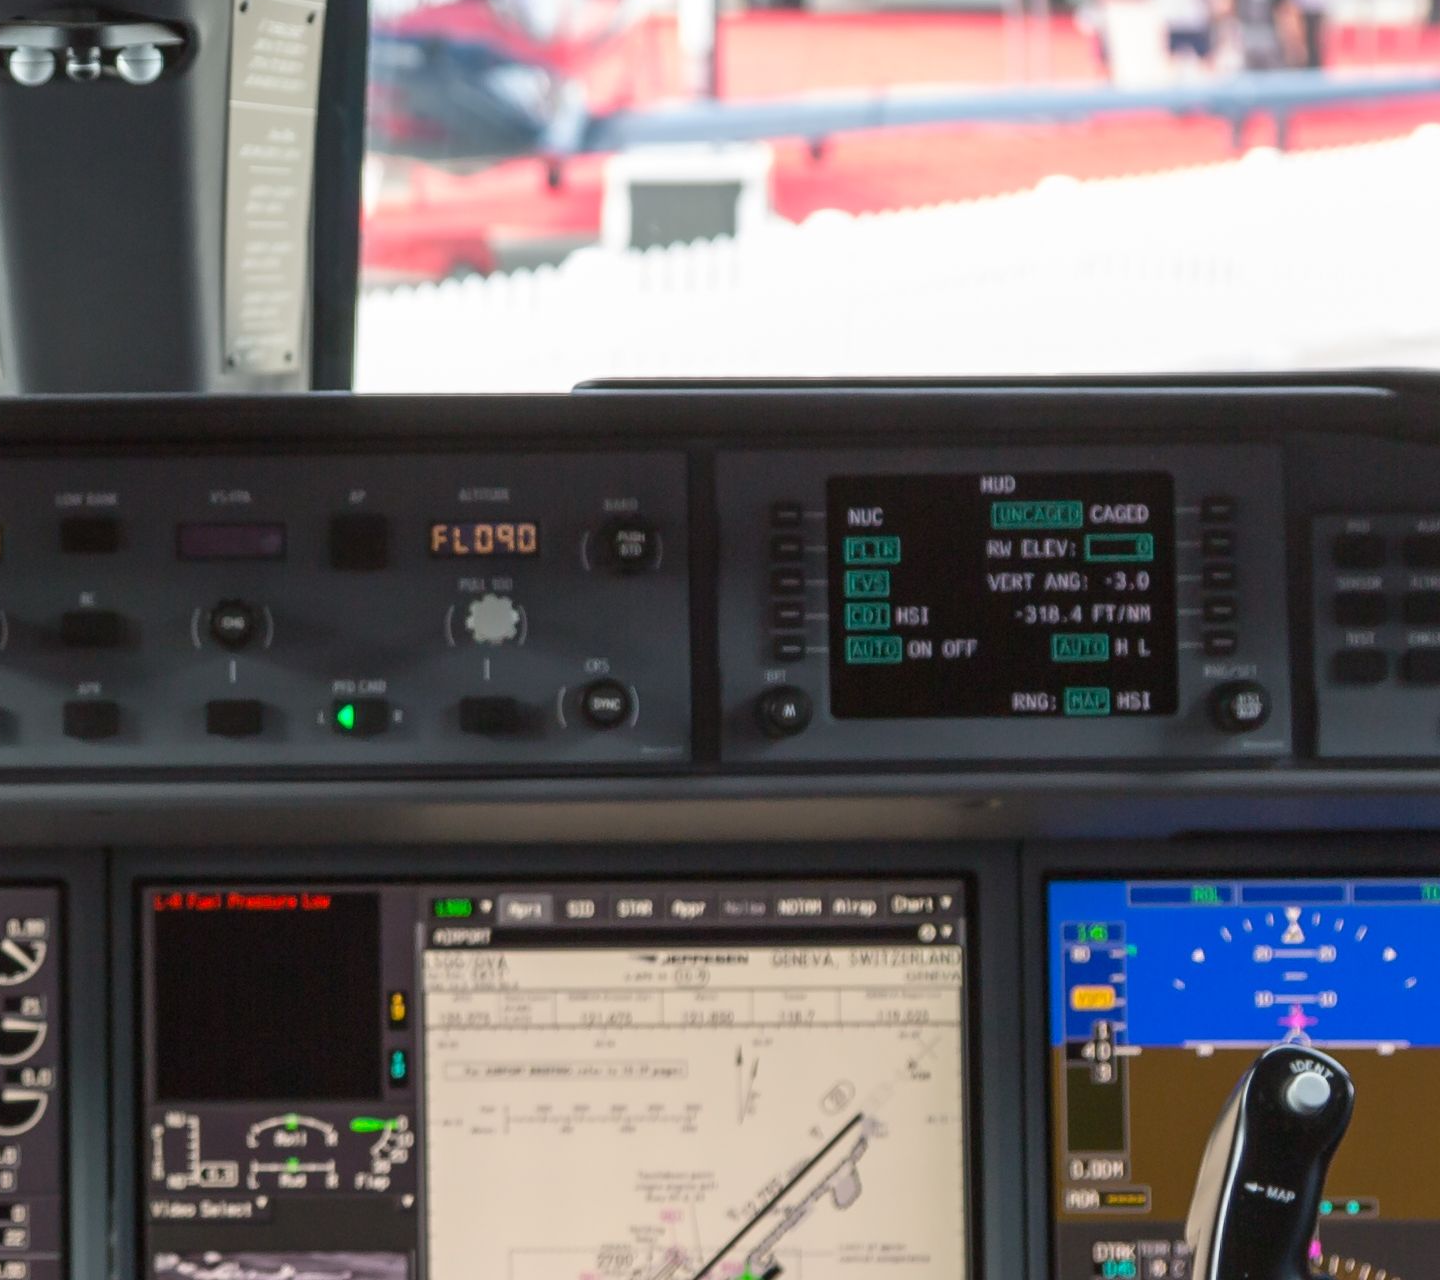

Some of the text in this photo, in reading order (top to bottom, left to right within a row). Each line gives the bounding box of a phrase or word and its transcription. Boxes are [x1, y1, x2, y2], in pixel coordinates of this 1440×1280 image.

[979, 475, 1016, 494] HUD
[847, 508, 884, 527] NUC
[1089, 504, 1150, 523] CAGED
[430, 523, 538, 555] FL090
[986, 572, 1033, 592] VERT
[906, 638, 978, 658] ON OFF
[1289, 1060, 1335, 1080] IDENT
[1265, 1184, 1296, 1205] MAP
